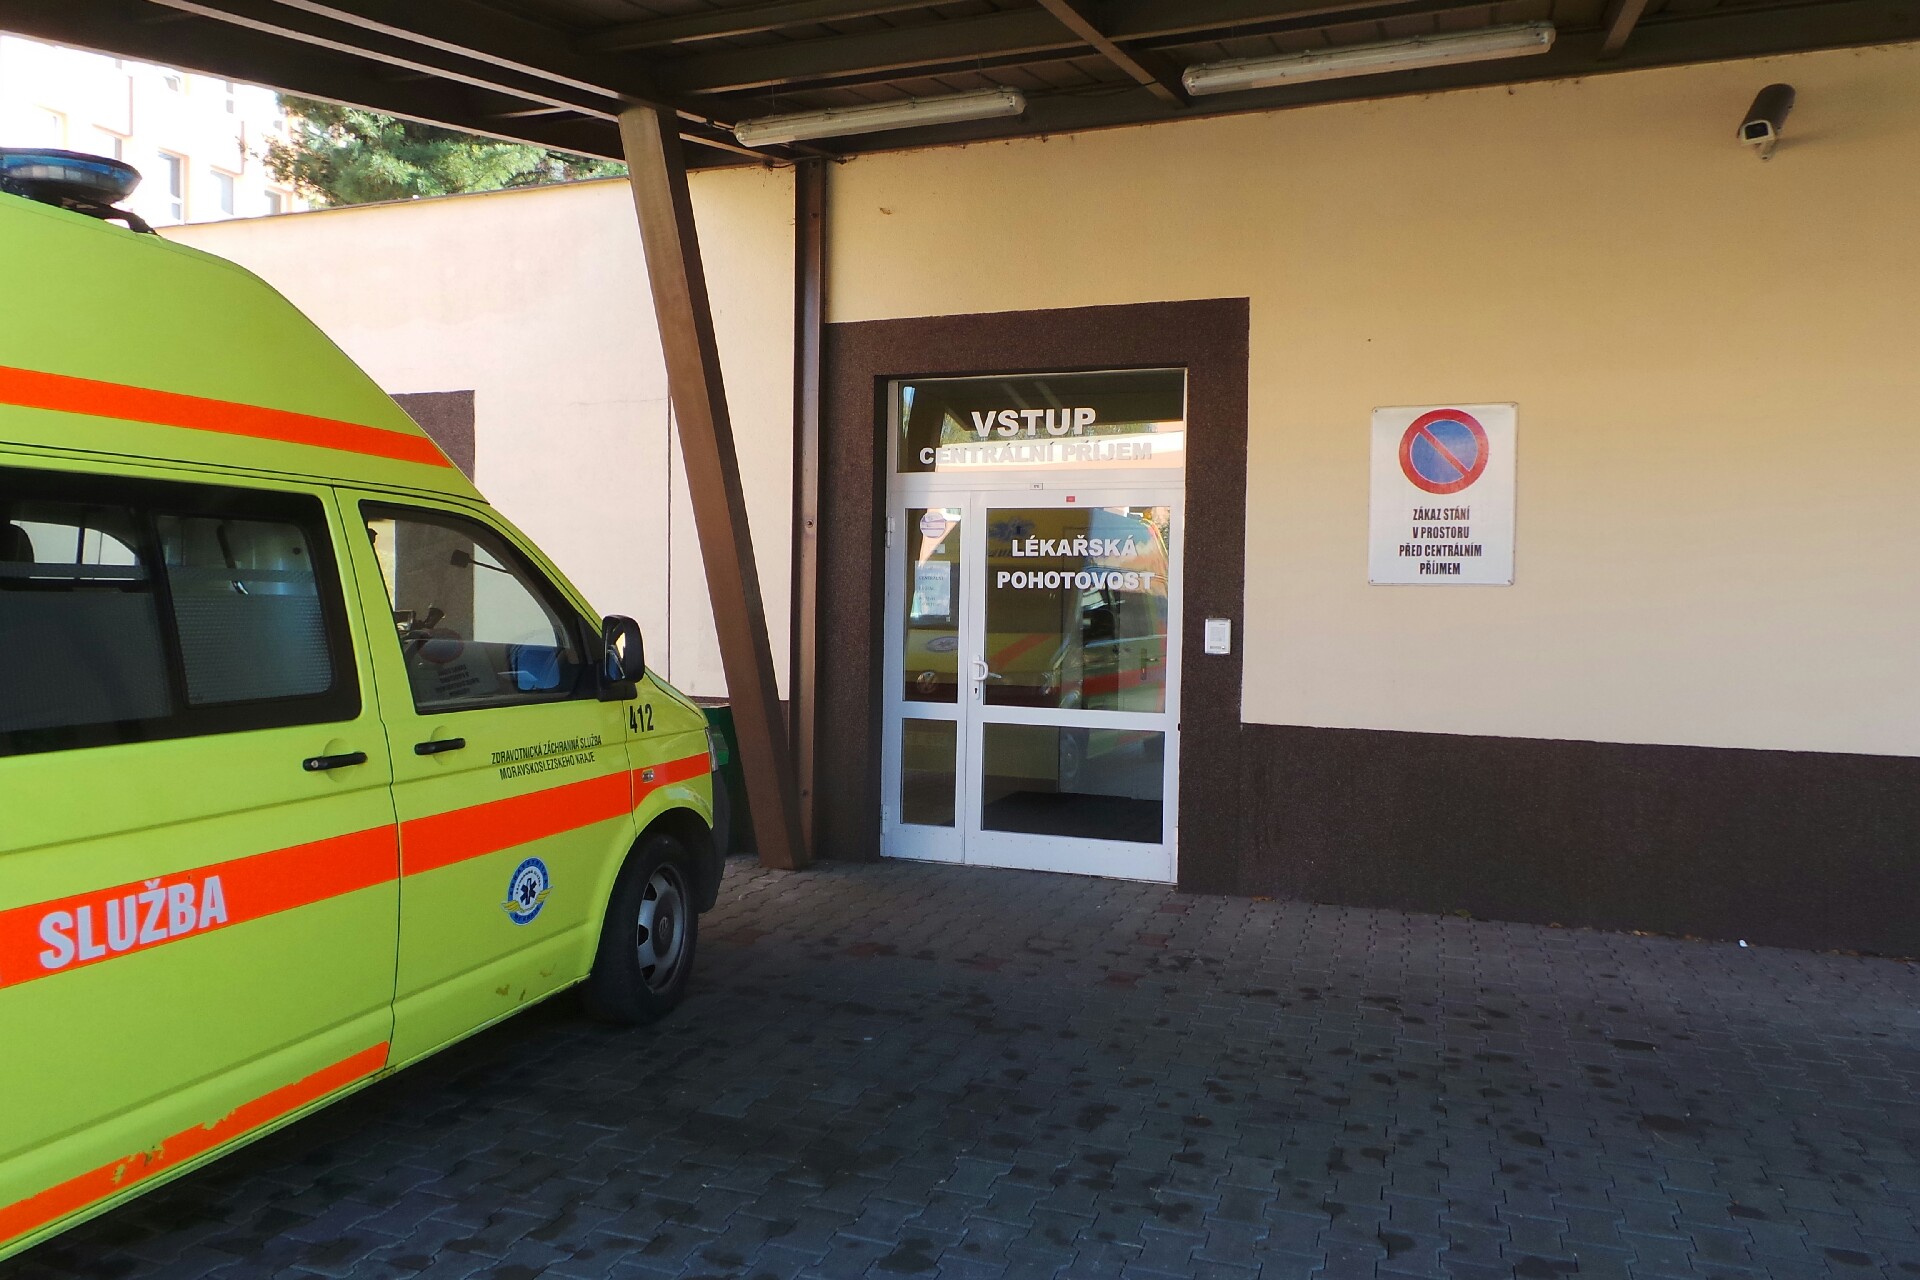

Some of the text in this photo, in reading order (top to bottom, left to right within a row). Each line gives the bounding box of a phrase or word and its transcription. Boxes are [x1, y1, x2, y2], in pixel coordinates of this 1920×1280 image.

[971, 408, 1096, 437] VSTUP
[919, 439, 1152, 465] CENTRÁLNÍ PŘÍJEM
[1412, 505, 1470, 521] ZÁKAZ STÁNÍ
[1412, 527, 1470, 539] V PROSTORU
[1012, 534, 1138, 557] LÉKAŘSKÁ
[1399, 542, 1482, 557] PŘED CENTRÁLNÍM
[1419, 559, 1461, 575] PŘÍJMEM
[997, 571, 1156, 590] POHOTOVOST
[629, 703, 654, 733] 412
[491, 733, 602, 765] ZDRAVOTNICKÁ ZÁCHRANNÁ SLUŽBA
[500, 751, 596, 781] MORAVSKOSLEZSKÉHO KRAJE
[39, 875, 228, 969] SLUŽBA
